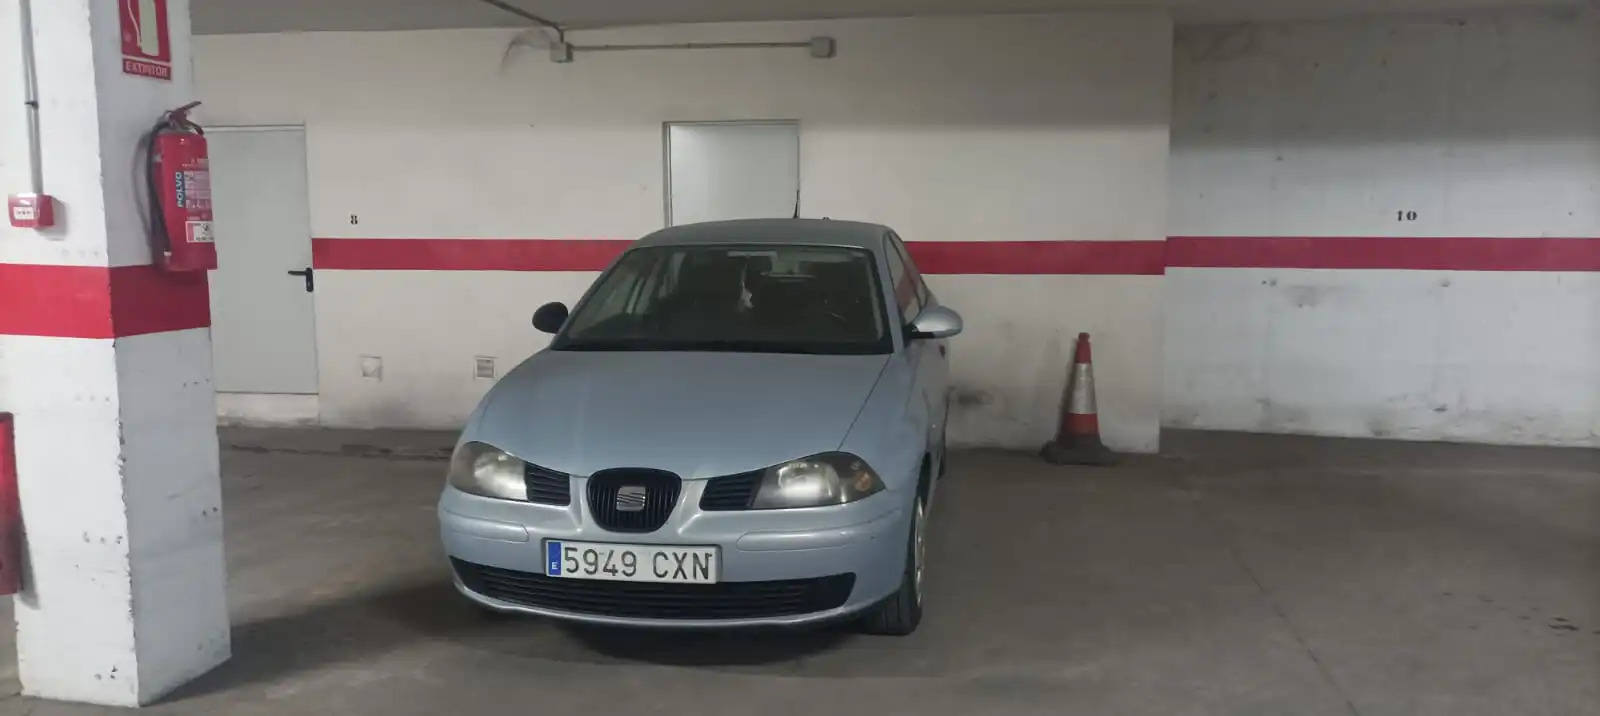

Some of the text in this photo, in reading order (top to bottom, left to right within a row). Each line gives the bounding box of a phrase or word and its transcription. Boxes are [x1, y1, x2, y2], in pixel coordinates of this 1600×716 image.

[124, 60, 168, 77] EXTINTOR
[175, 171, 184, 208] POLVO
[350, 214, 358, 225] 8
[1396, 209, 1418, 221] 10
[551, 561, 559, 570] E
[563, 546, 711, 580] 5949 CXN
